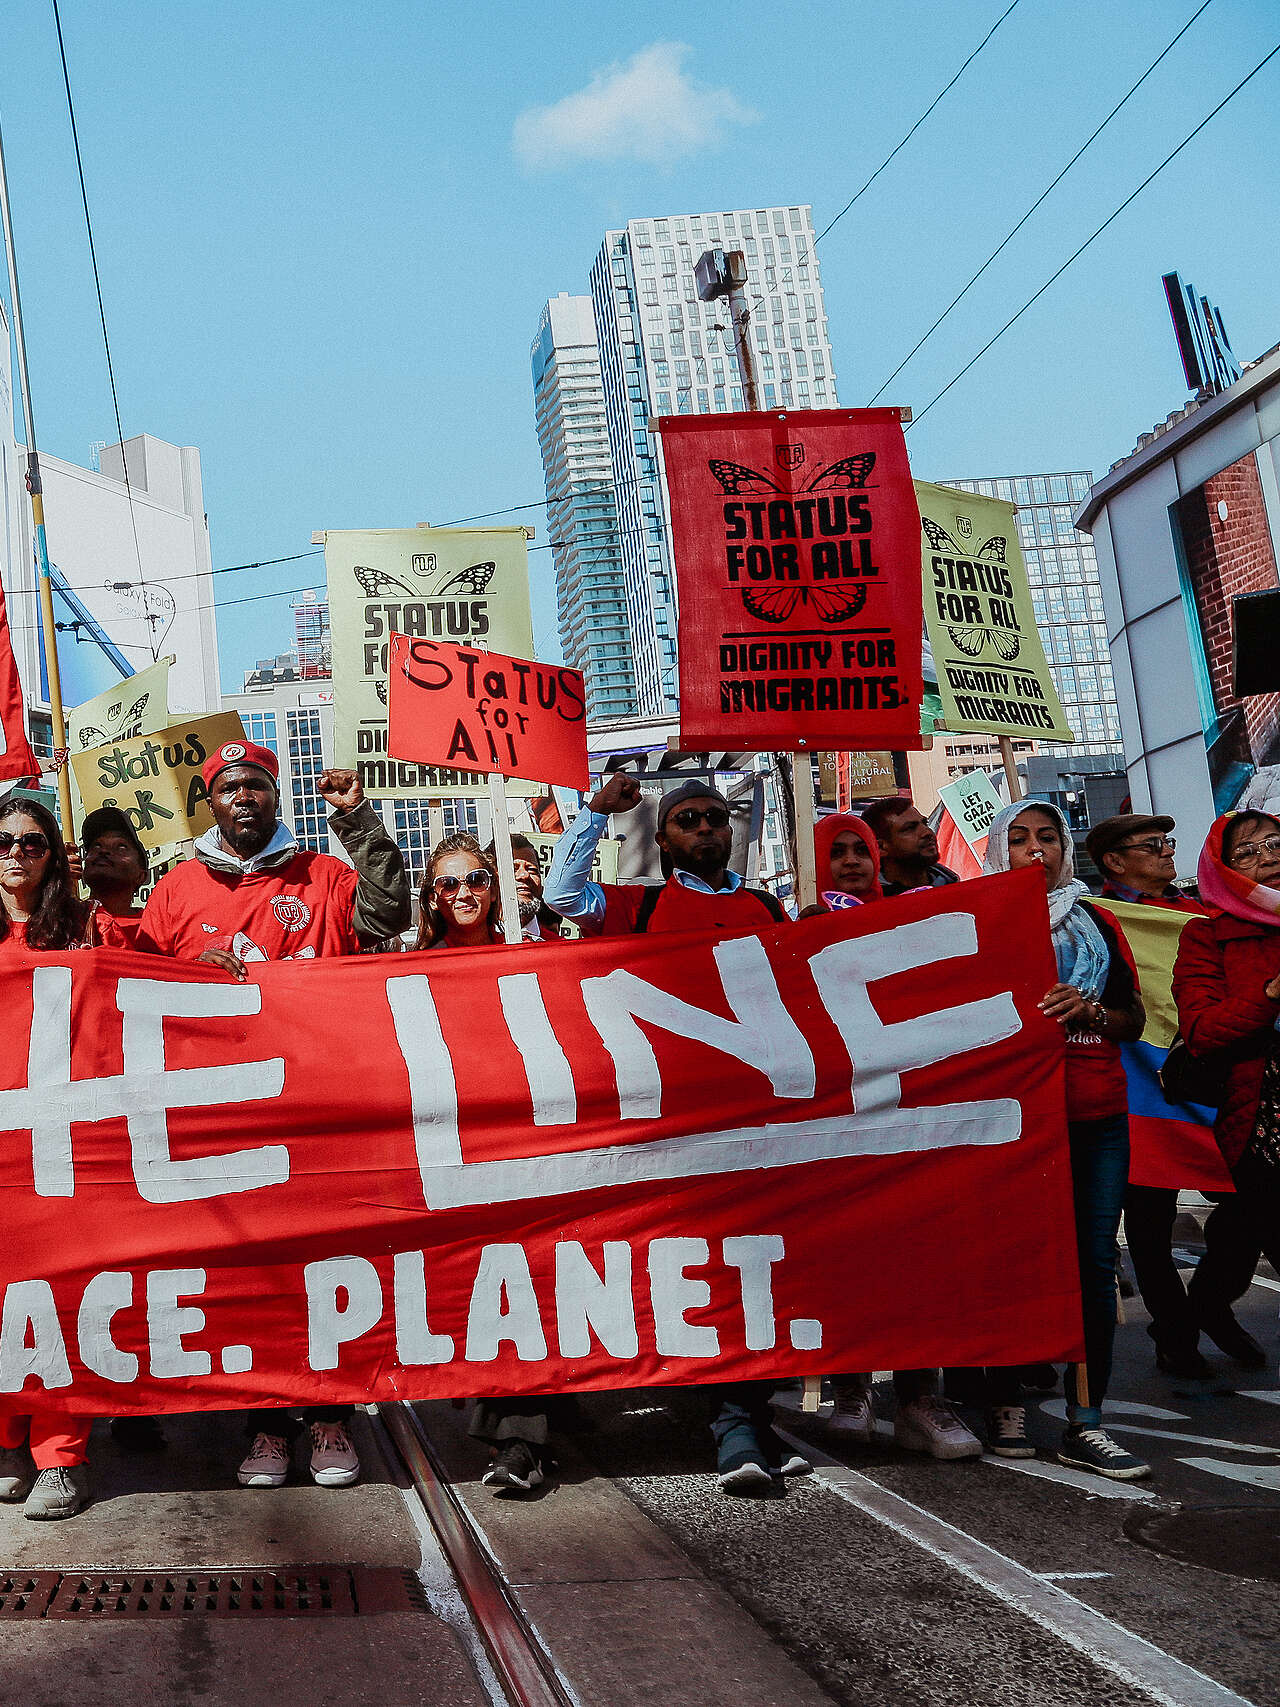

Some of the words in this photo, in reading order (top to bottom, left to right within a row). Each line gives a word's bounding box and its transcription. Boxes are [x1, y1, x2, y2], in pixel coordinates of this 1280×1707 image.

[723, 494, 872, 540] STATUS
[726, 543, 801, 582] FOR
[811, 537, 879, 580] ALL
[931, 555, 1013, 598] STATUS
[364, 601, 490, 638] STATUS
[935, 591, 984, 624] FOR
[990, 600, 1021, 632] ALL
[720, 641, 832, 673] DIGNITY
[842, 639, 896, 668] FOR
[945, 667, 1010, 697] DIGNITY
[1014, 676, 1044, 700] FOR
[477, 699, 530, 736] for
[953, 694, 1055, 730] MIGRANTS
[98, 733, 207, 788] Status
[851, 767, 891, 777] ULTURAL
[961, 792, 982, 809] LET
[964, 800, 995, 823] GAZA
[971, 813, 996, 833] LIVE
[387, 911, 1023, 1210] LINE
[304, 1235, 823, 1370] PLANET.
